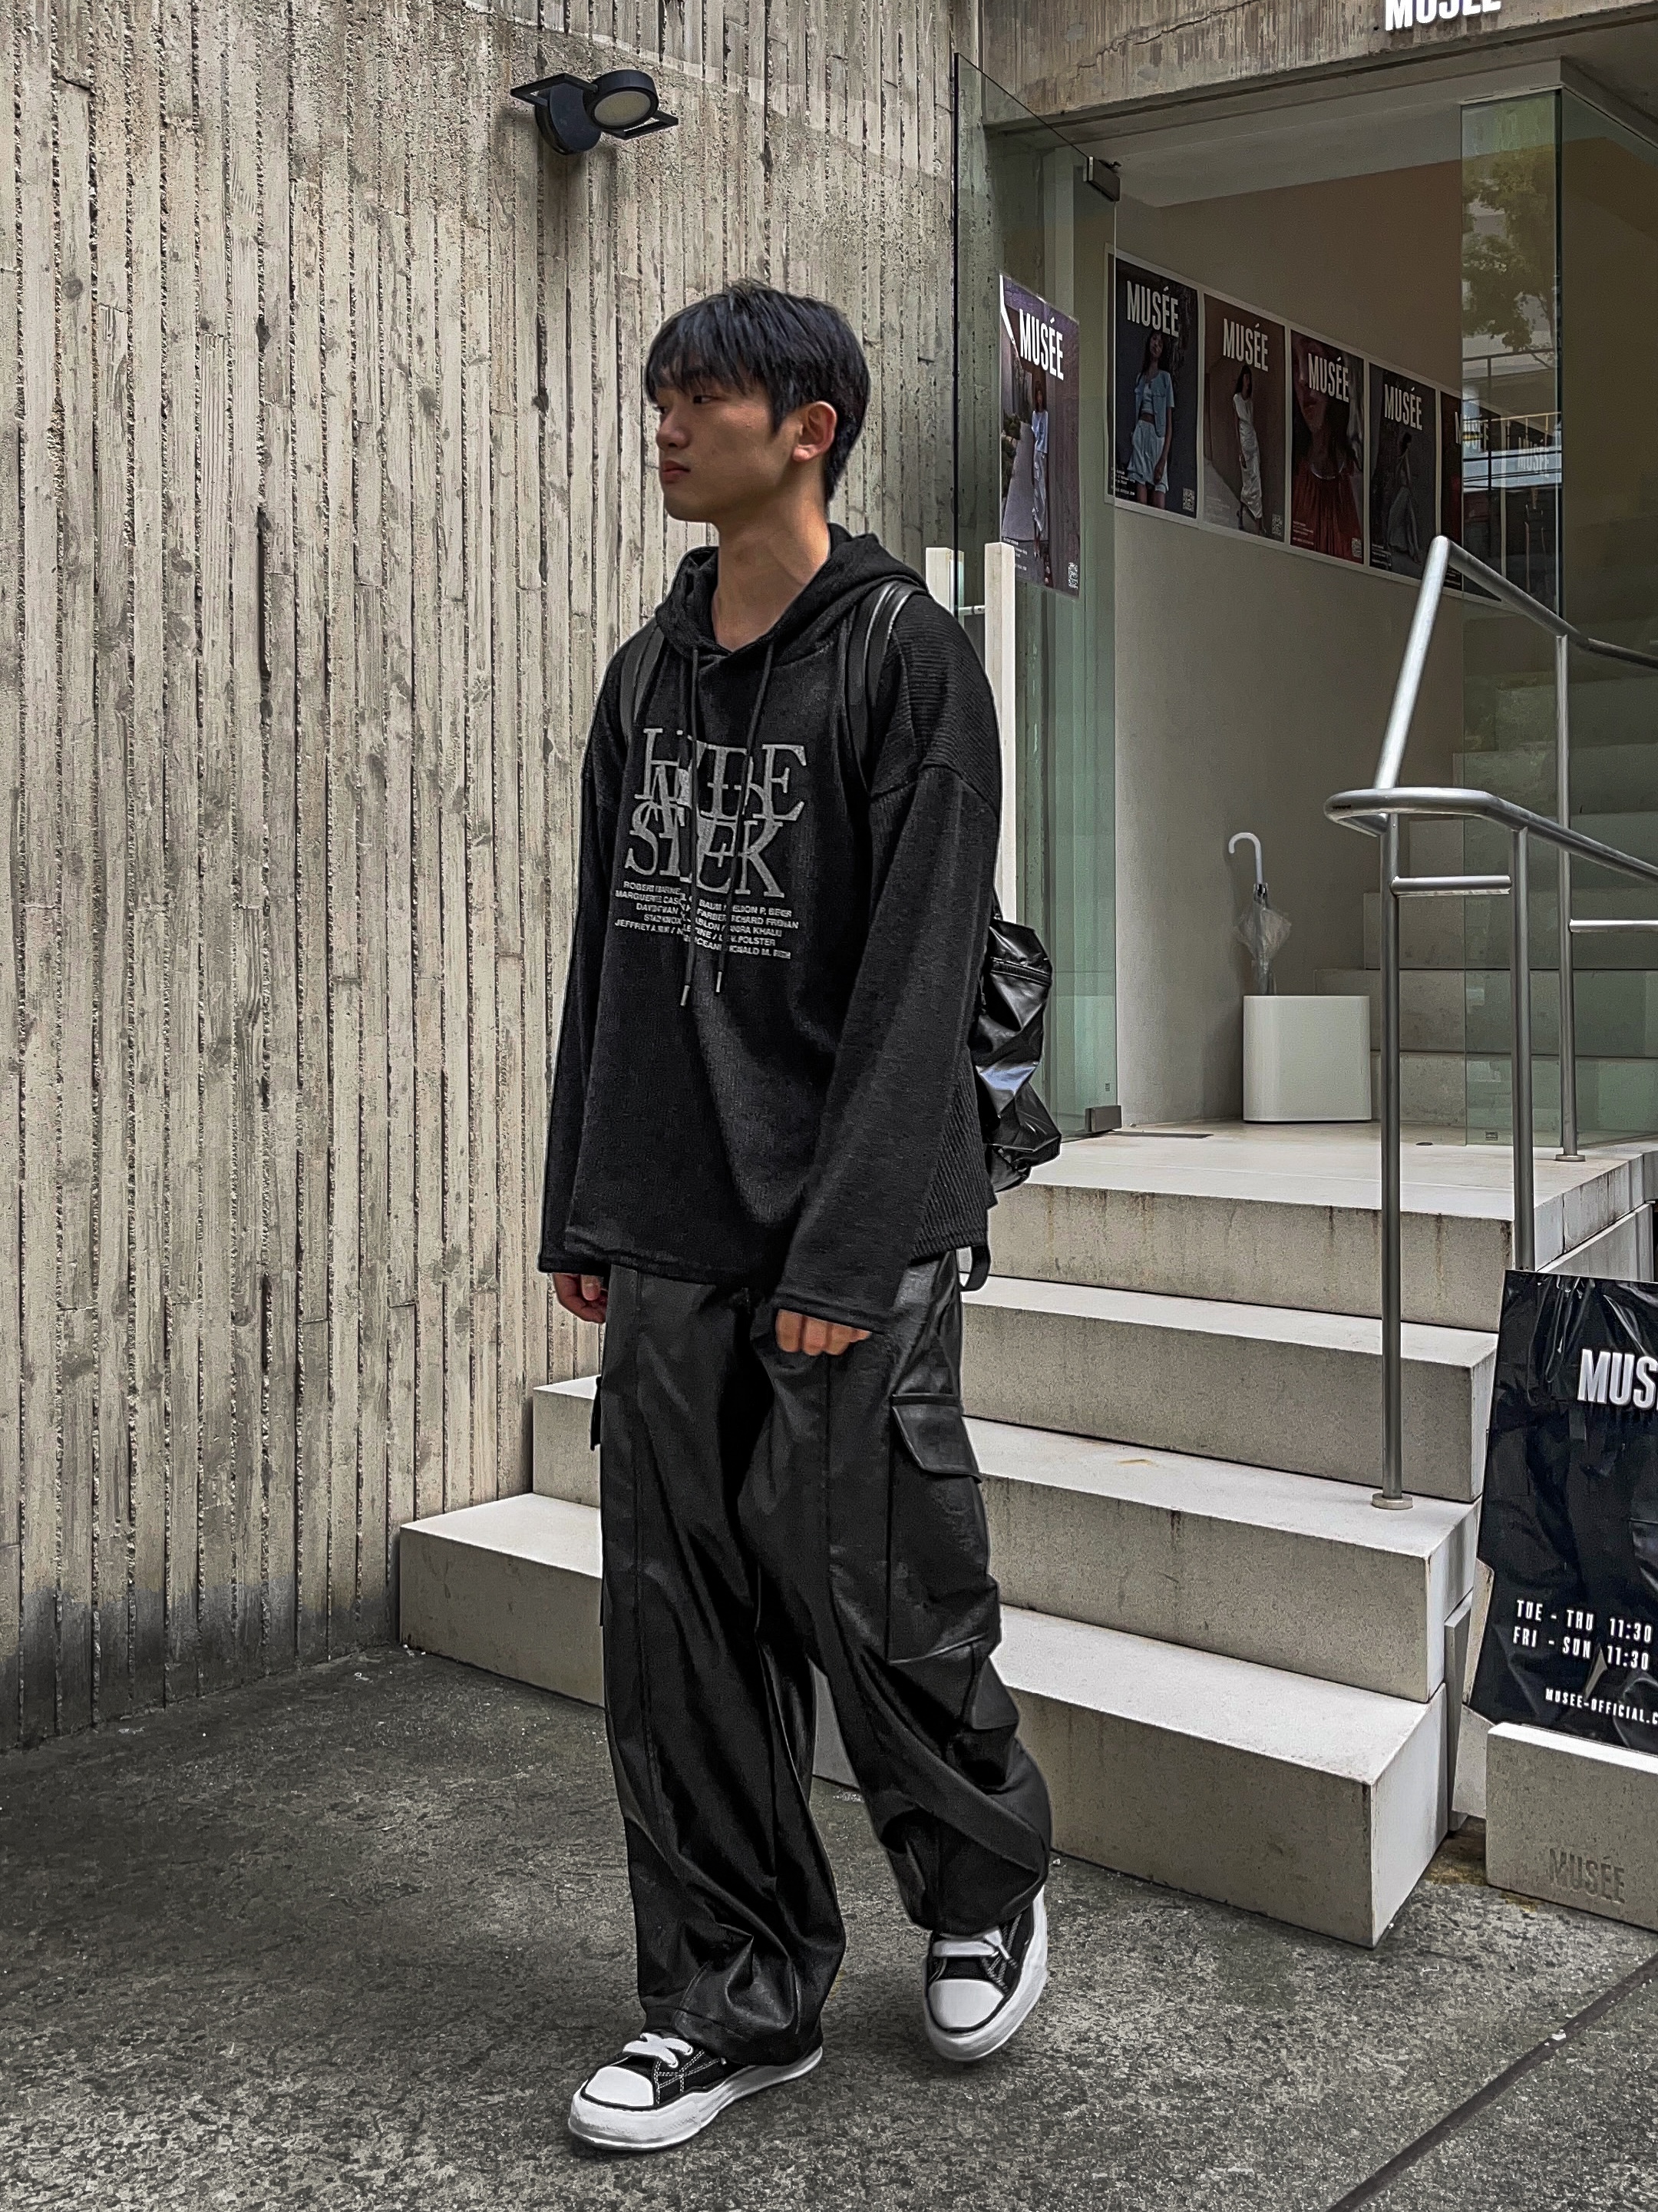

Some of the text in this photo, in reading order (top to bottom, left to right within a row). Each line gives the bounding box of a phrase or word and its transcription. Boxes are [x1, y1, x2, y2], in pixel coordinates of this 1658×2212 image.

[1126, 279, 1179, 338] MUSÉE
[1019, 308, 1064, 381] MUSÉE
[1223, 318, 1269, 372] MUSÉE
[1308, 352, 1349, 403] MUSÉE
[1384, 384, 1423, 431] MUSÉE
[1577, 1348, 1658, 1410] MUS
[1513, 1625, 1537, 1648] FRI
[1562, 1636, 1591, 1659] SUN
[1607, 1645, 1649, 1671] 11:30
[1517, 1599, 1544, 1622] TUE
[1567, 1609, 1594, 1632] THU
[1610, 1617, 1652, 1643] 11:30
[1549, 1847, 1626, 1905] MUSÉE
